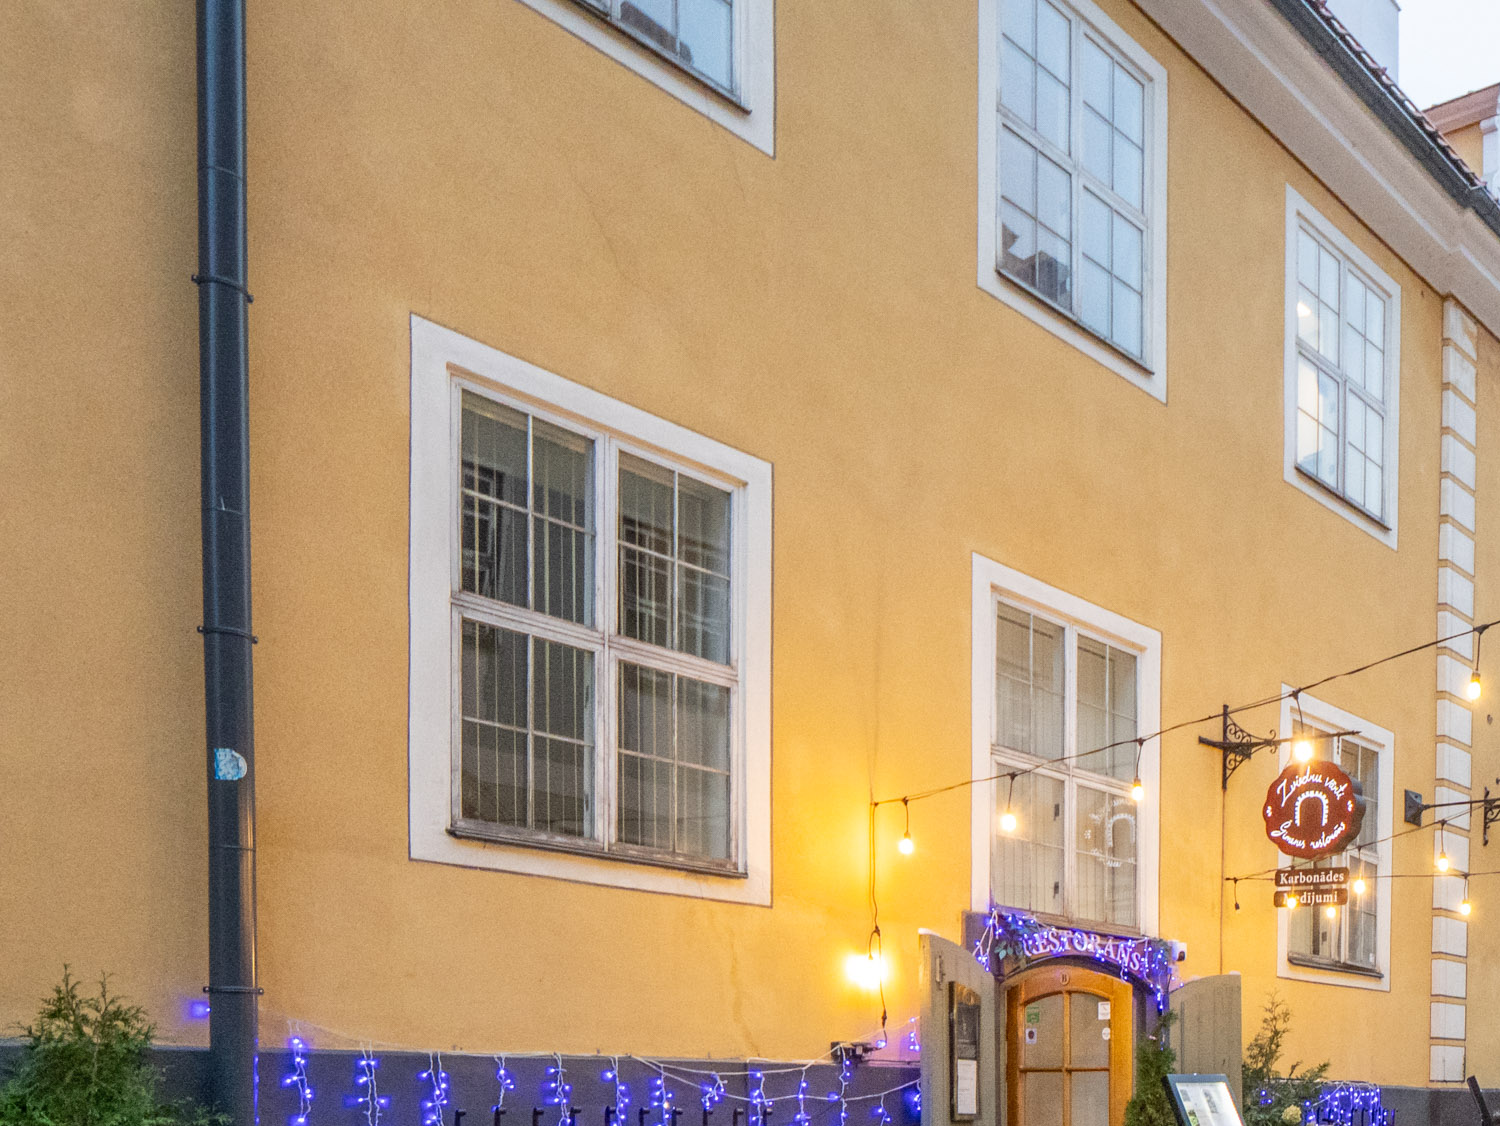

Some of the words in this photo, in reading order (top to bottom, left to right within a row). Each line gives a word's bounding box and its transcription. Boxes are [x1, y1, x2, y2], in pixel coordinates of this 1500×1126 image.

[1276, 766, 1322, 807] Zviedru
[1280, 870, 1344, 885] Karbonādes
[1283, 891, 1338, 907] Mdījumi
